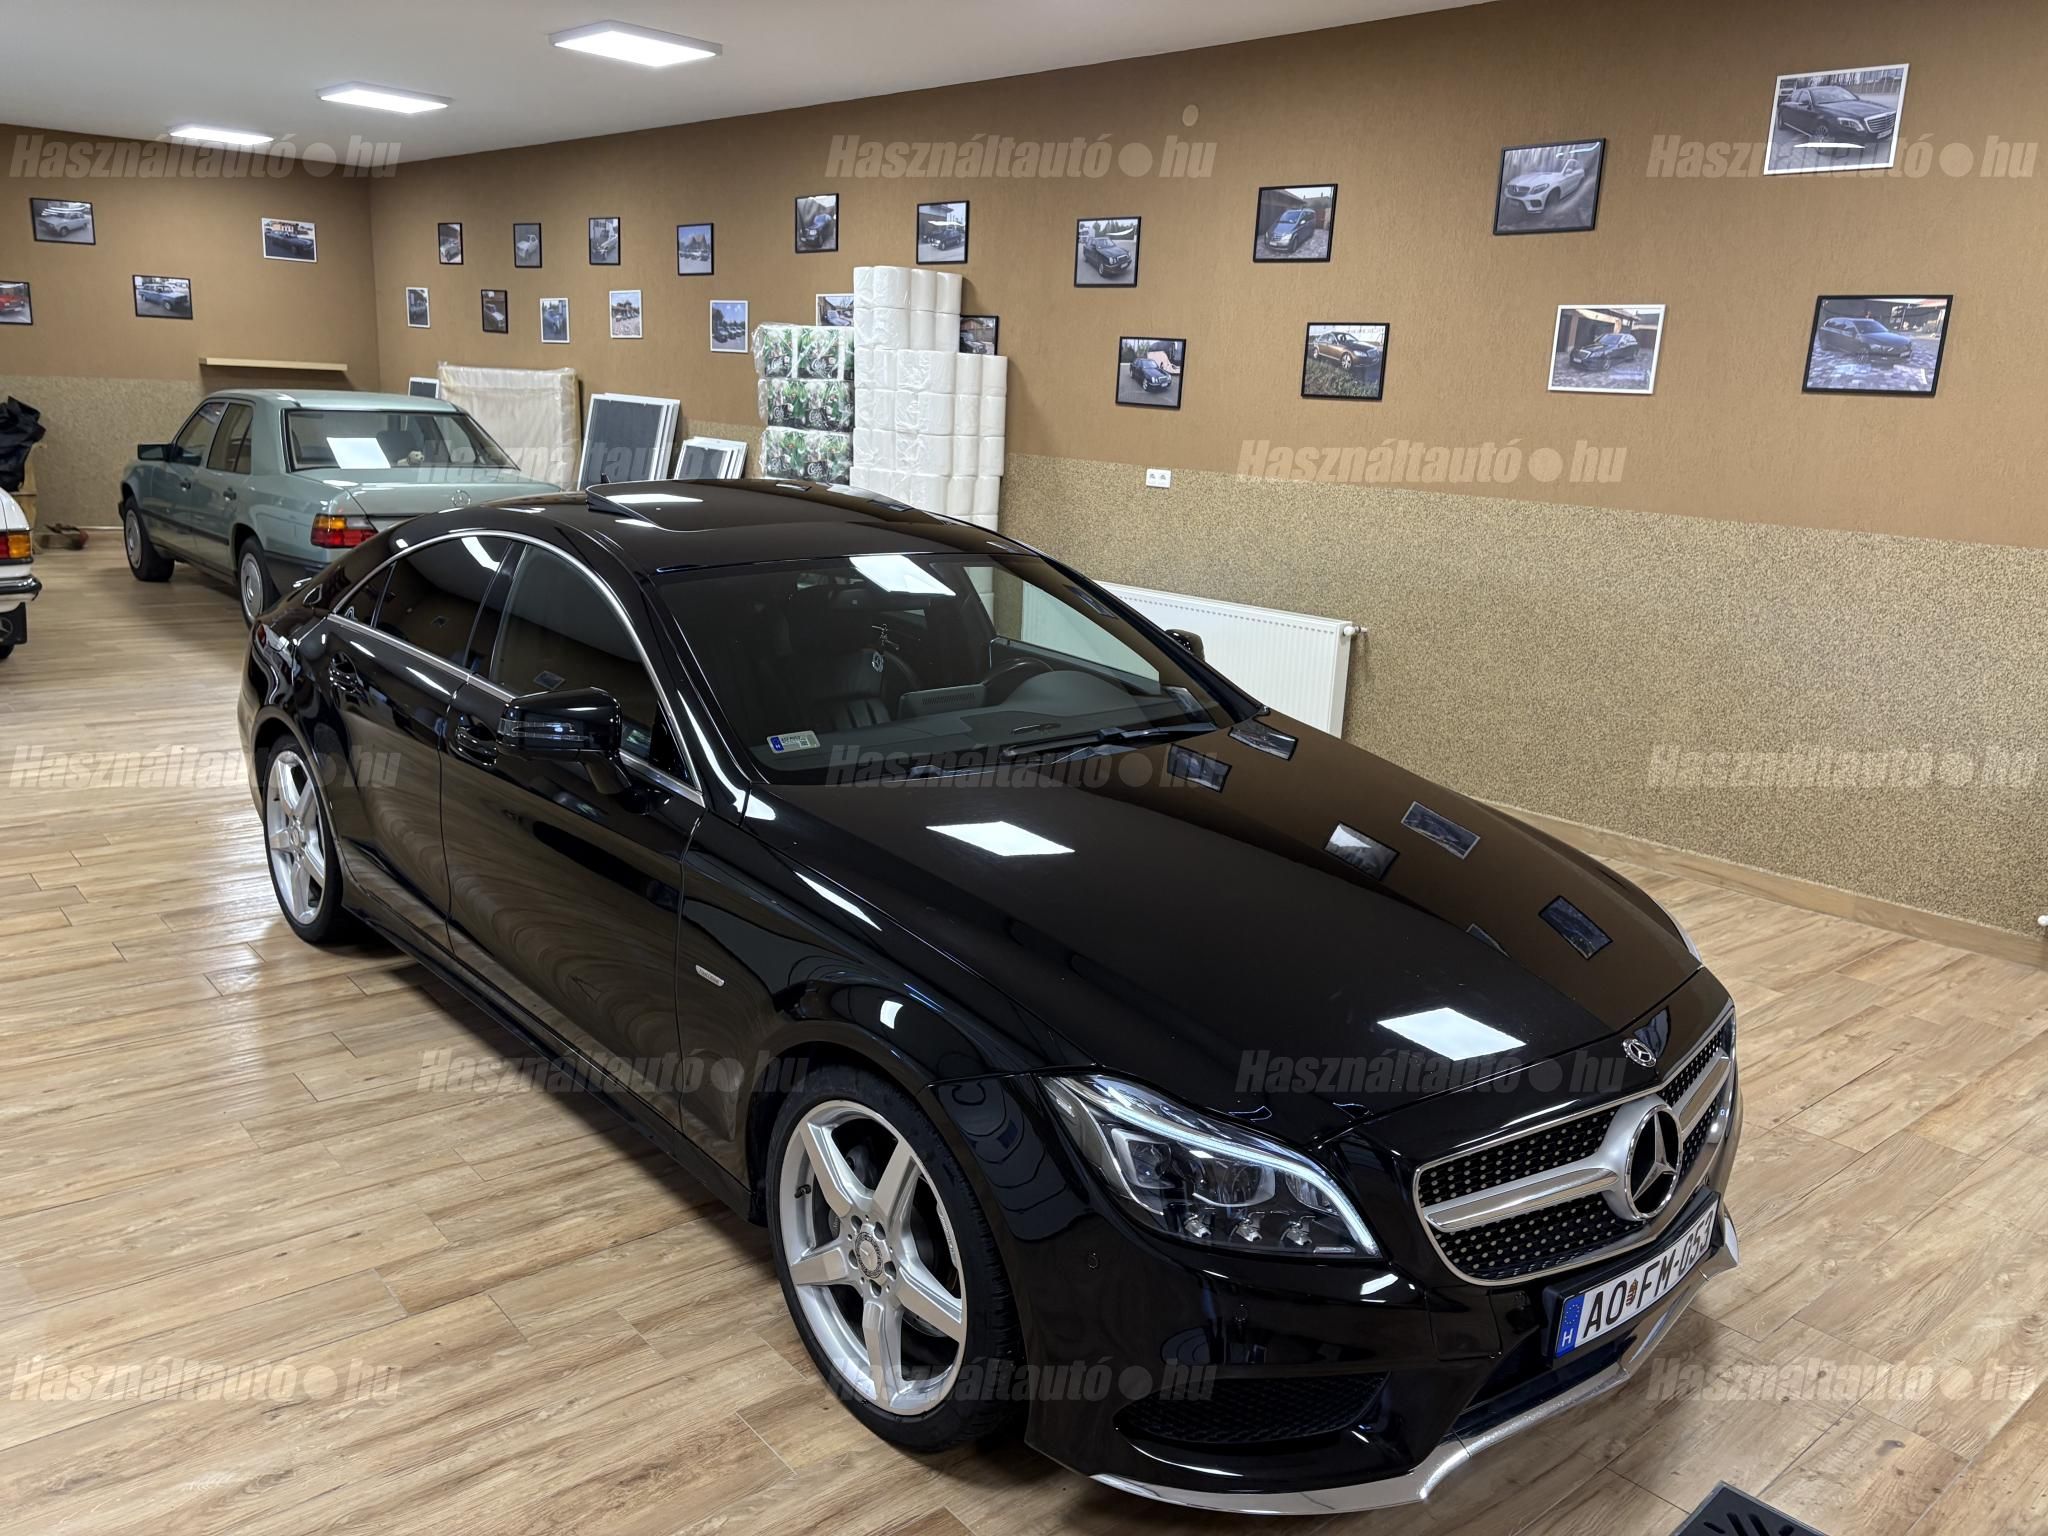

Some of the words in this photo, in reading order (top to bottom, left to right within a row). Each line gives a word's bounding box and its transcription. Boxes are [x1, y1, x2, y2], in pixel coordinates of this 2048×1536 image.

[1583, 1280, 1628, 1339] AO
[1636, 1210, 1714, 1309] FM-053
[1562, 1328, 1574, 1347] H
